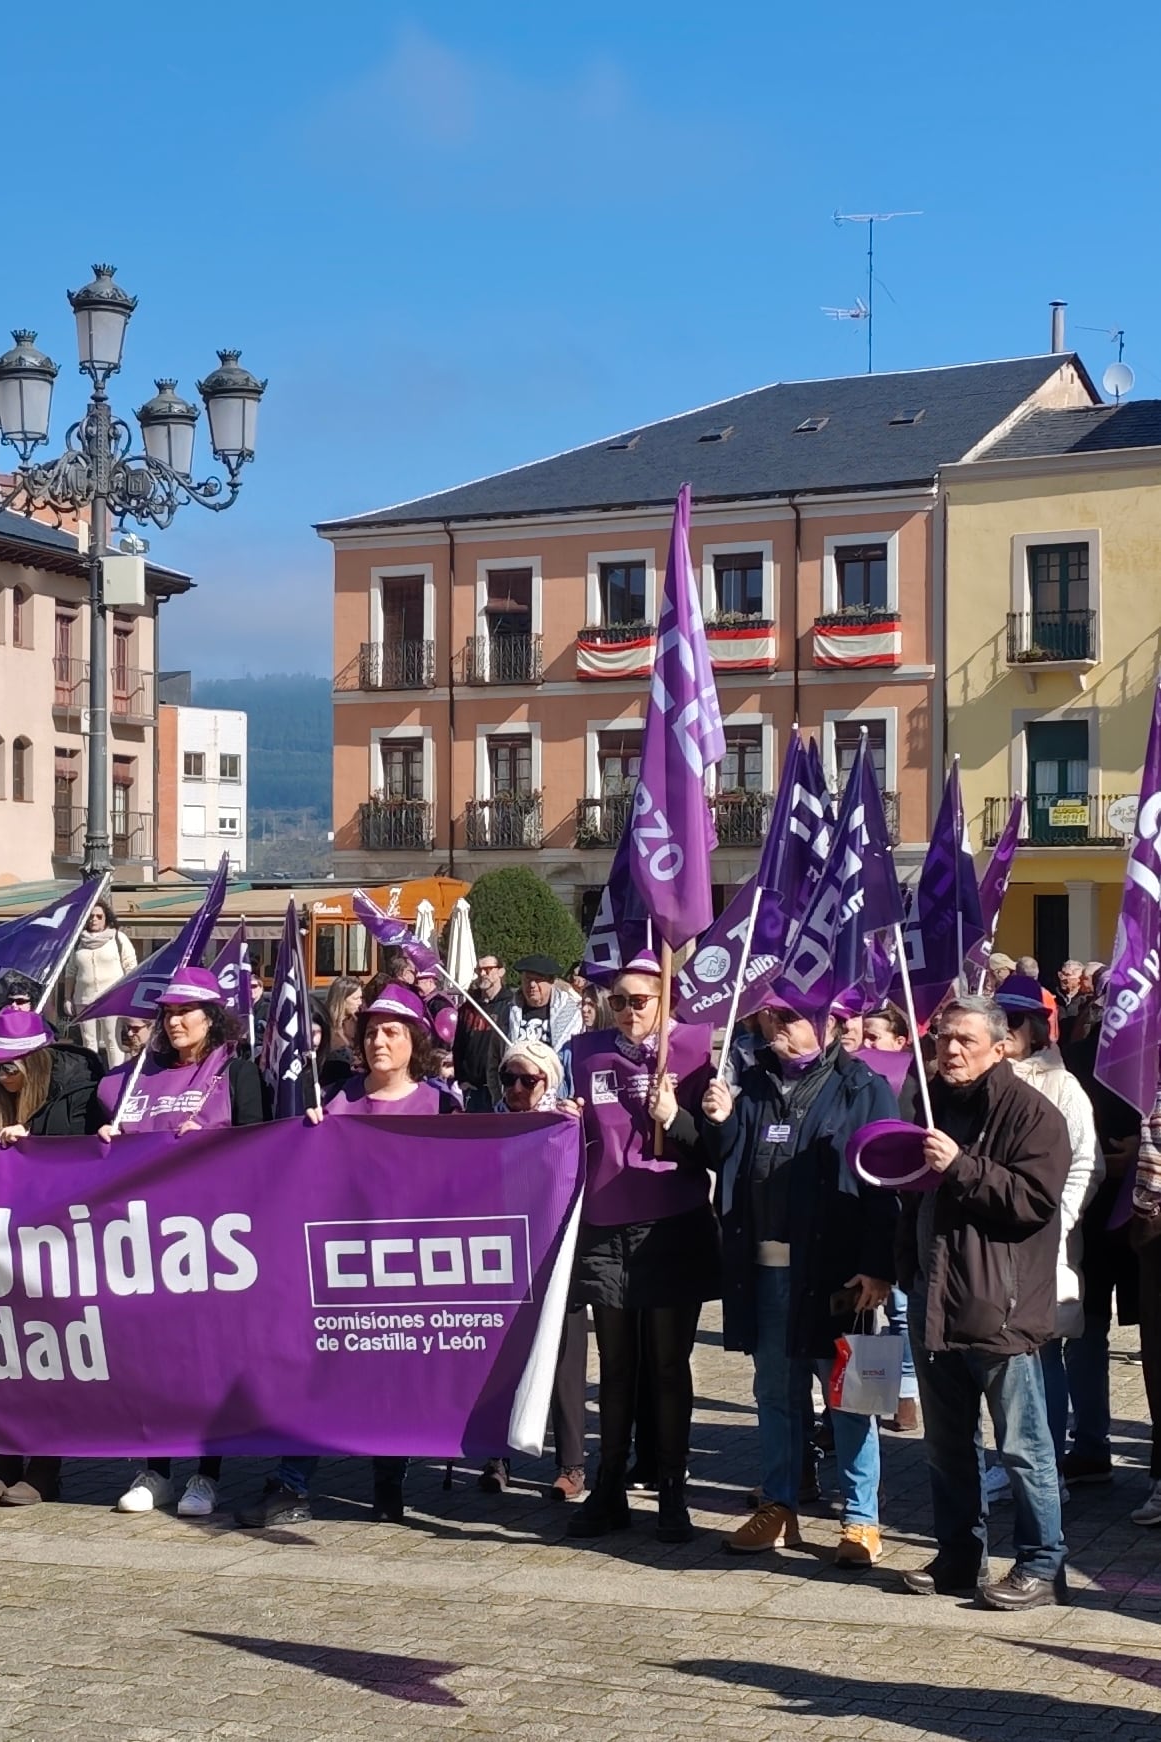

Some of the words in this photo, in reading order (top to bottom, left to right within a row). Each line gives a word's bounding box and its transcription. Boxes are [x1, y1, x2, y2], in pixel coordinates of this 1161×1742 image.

[324, 1235, 515, 1289] CCOO
[313, 1311, 426, 1331] comisiones
[429, 1309, 505, 1329] obreras
[315, 1334, 340, 1352] de
[343, 1332, 418, 1352] Castilla
[422, 1336, 434, 1355] y
[437, 1331, 487, 1351] León
